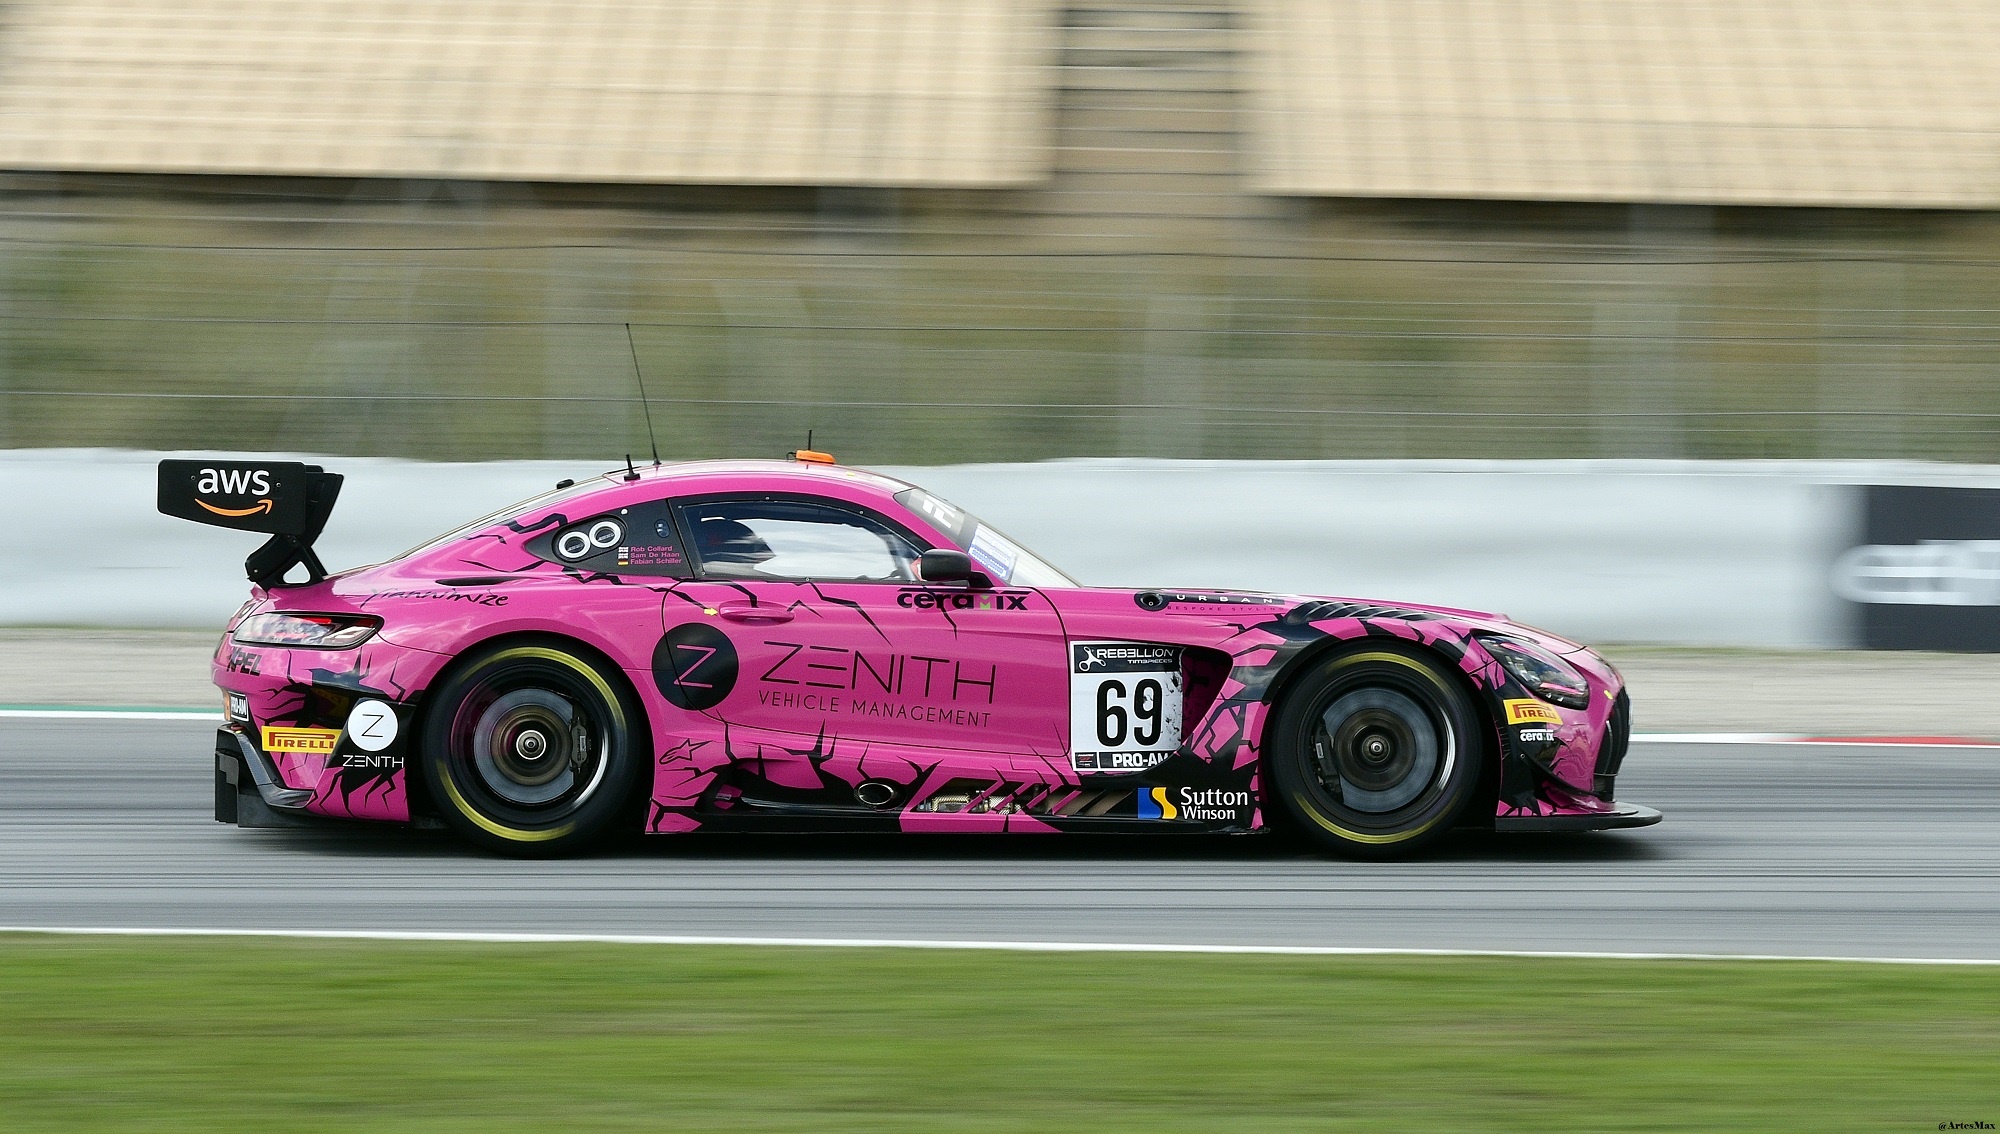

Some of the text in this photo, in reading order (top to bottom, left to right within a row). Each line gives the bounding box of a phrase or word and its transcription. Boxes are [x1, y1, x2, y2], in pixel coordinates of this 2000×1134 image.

[197, 468, 270, 496] aws
[1176, 594, 1273, 604] URBAN
[1096, 648, 1174, 659] REBELLION
[759, 641, 996, 704] ZENITH
[758, 690, 992, 728] VEHICLE MANAGEMENT
[1096, 678, 1163, 747] 69
[269, 732, 336, 749] PIRELLI
[342, 754, 405, 769] ZENITH
[1112, 752, 1169, 768] PRO-AM
[1180, 786, 1249, 806] Sutton
[1181, 806, 1236, 820] Winson
